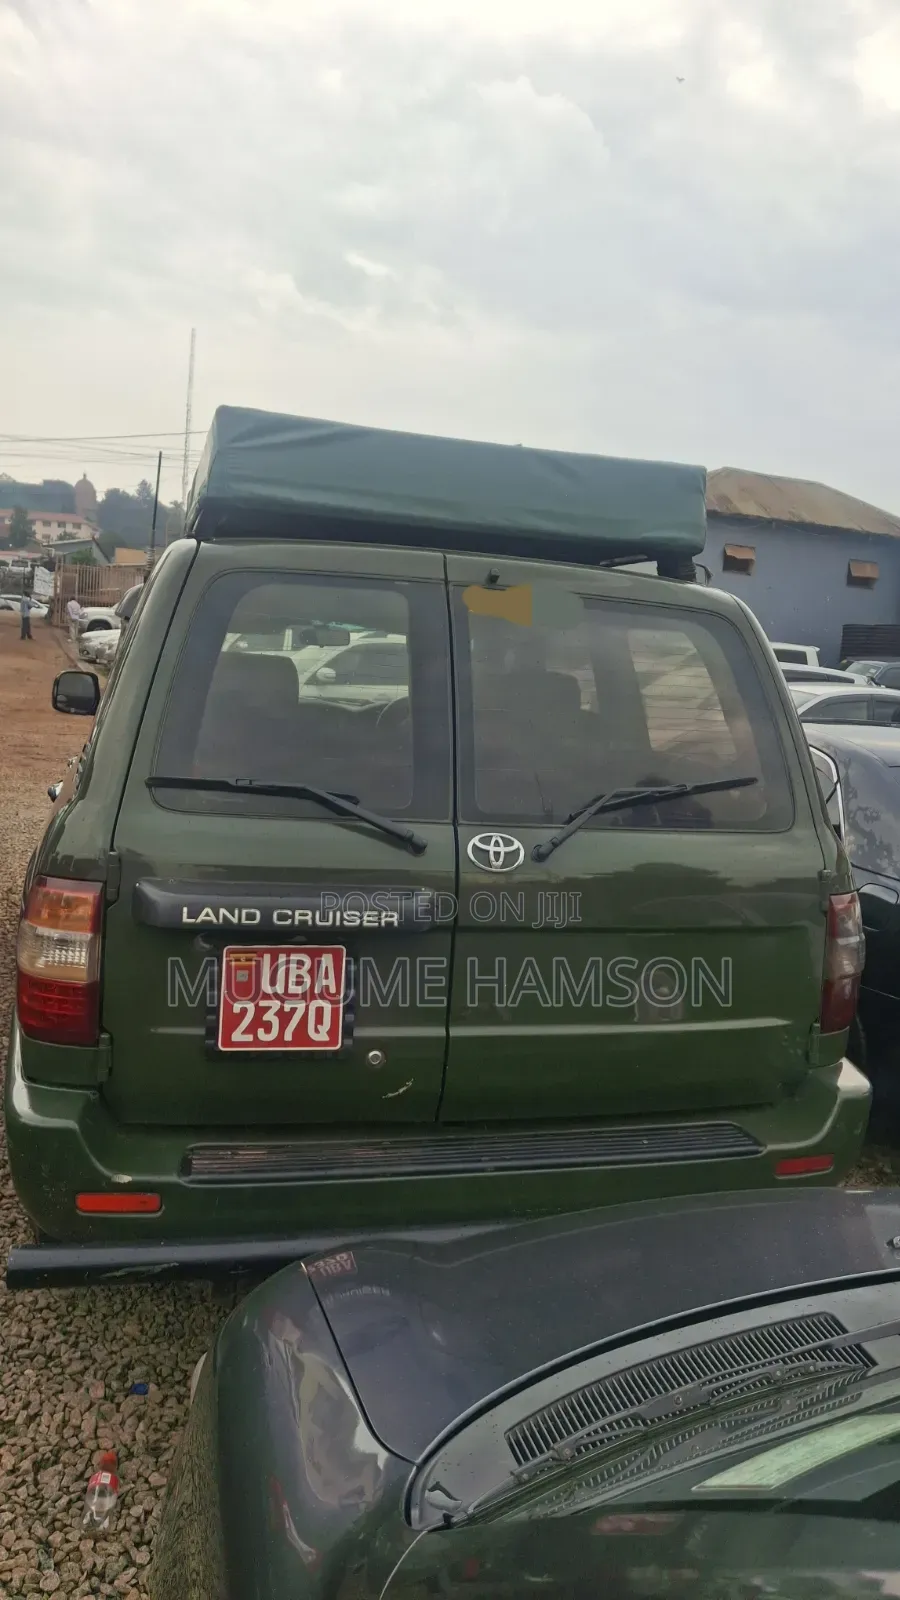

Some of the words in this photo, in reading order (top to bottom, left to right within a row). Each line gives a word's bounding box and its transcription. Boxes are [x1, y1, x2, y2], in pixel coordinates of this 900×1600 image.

[181, 906, 261, 924] LAND
[272, 909, 399, 928] CRUISER
[261, 953, 337, 995] UBA
[230, 1000, 332, 1042] 237Q
